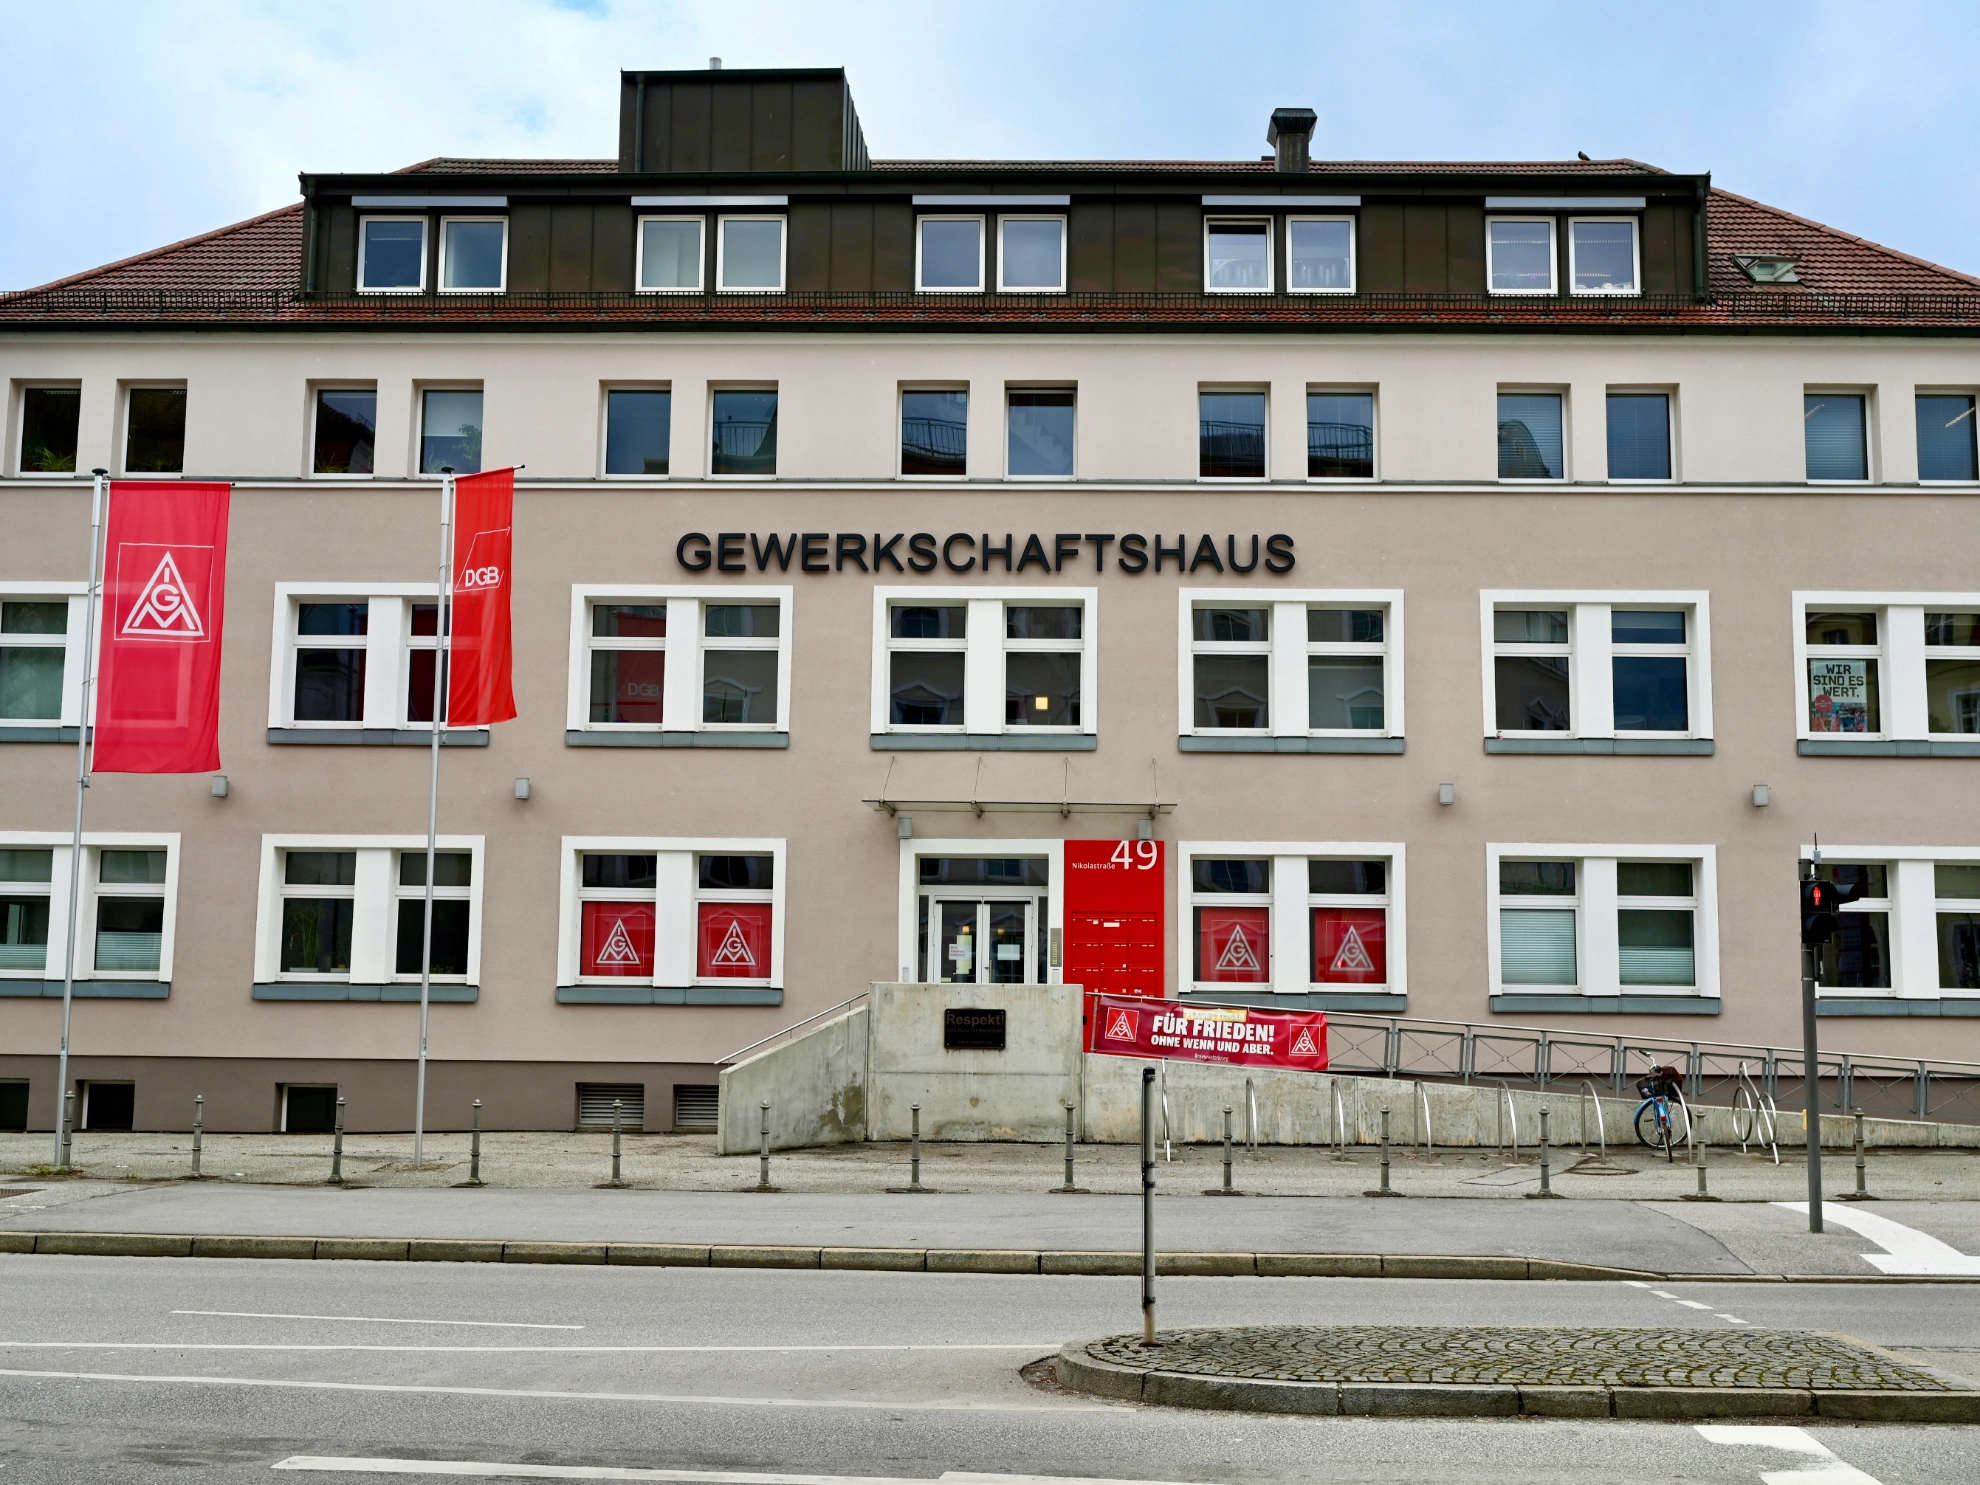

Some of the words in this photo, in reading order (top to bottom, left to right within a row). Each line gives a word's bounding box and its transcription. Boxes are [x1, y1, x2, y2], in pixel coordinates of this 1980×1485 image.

[675, 531, 1297, 574] GEWERKSCHAFTSHAUS
[464, 565, 500, 588] DGB
[1825, 663, 1852, 675] WIR
[627, 682, 660, 697] DGB
[1813, 675, 1845, 686] SIND
[1848, 675, 1864, 686] ES
[1822, 686, 1860, 698] WERT.
[1071, 862, 1116, 870] Nikolastraße
[1110, 839, 1158, 871] 49
[946, 1013, 1004, 1028] Respekt!
[1152, 1012, 1188, 1035] FÜR
[1192, 1019, 1275, 1043] FRIEDEN!
[1151, 1034, 1180, 1048] OHNE
[1183, 1037, 1215, 1051] WENN
[1216, 1040, 1240, 1053] UND
[1242, 1043, 1274, 1056] ABER.
